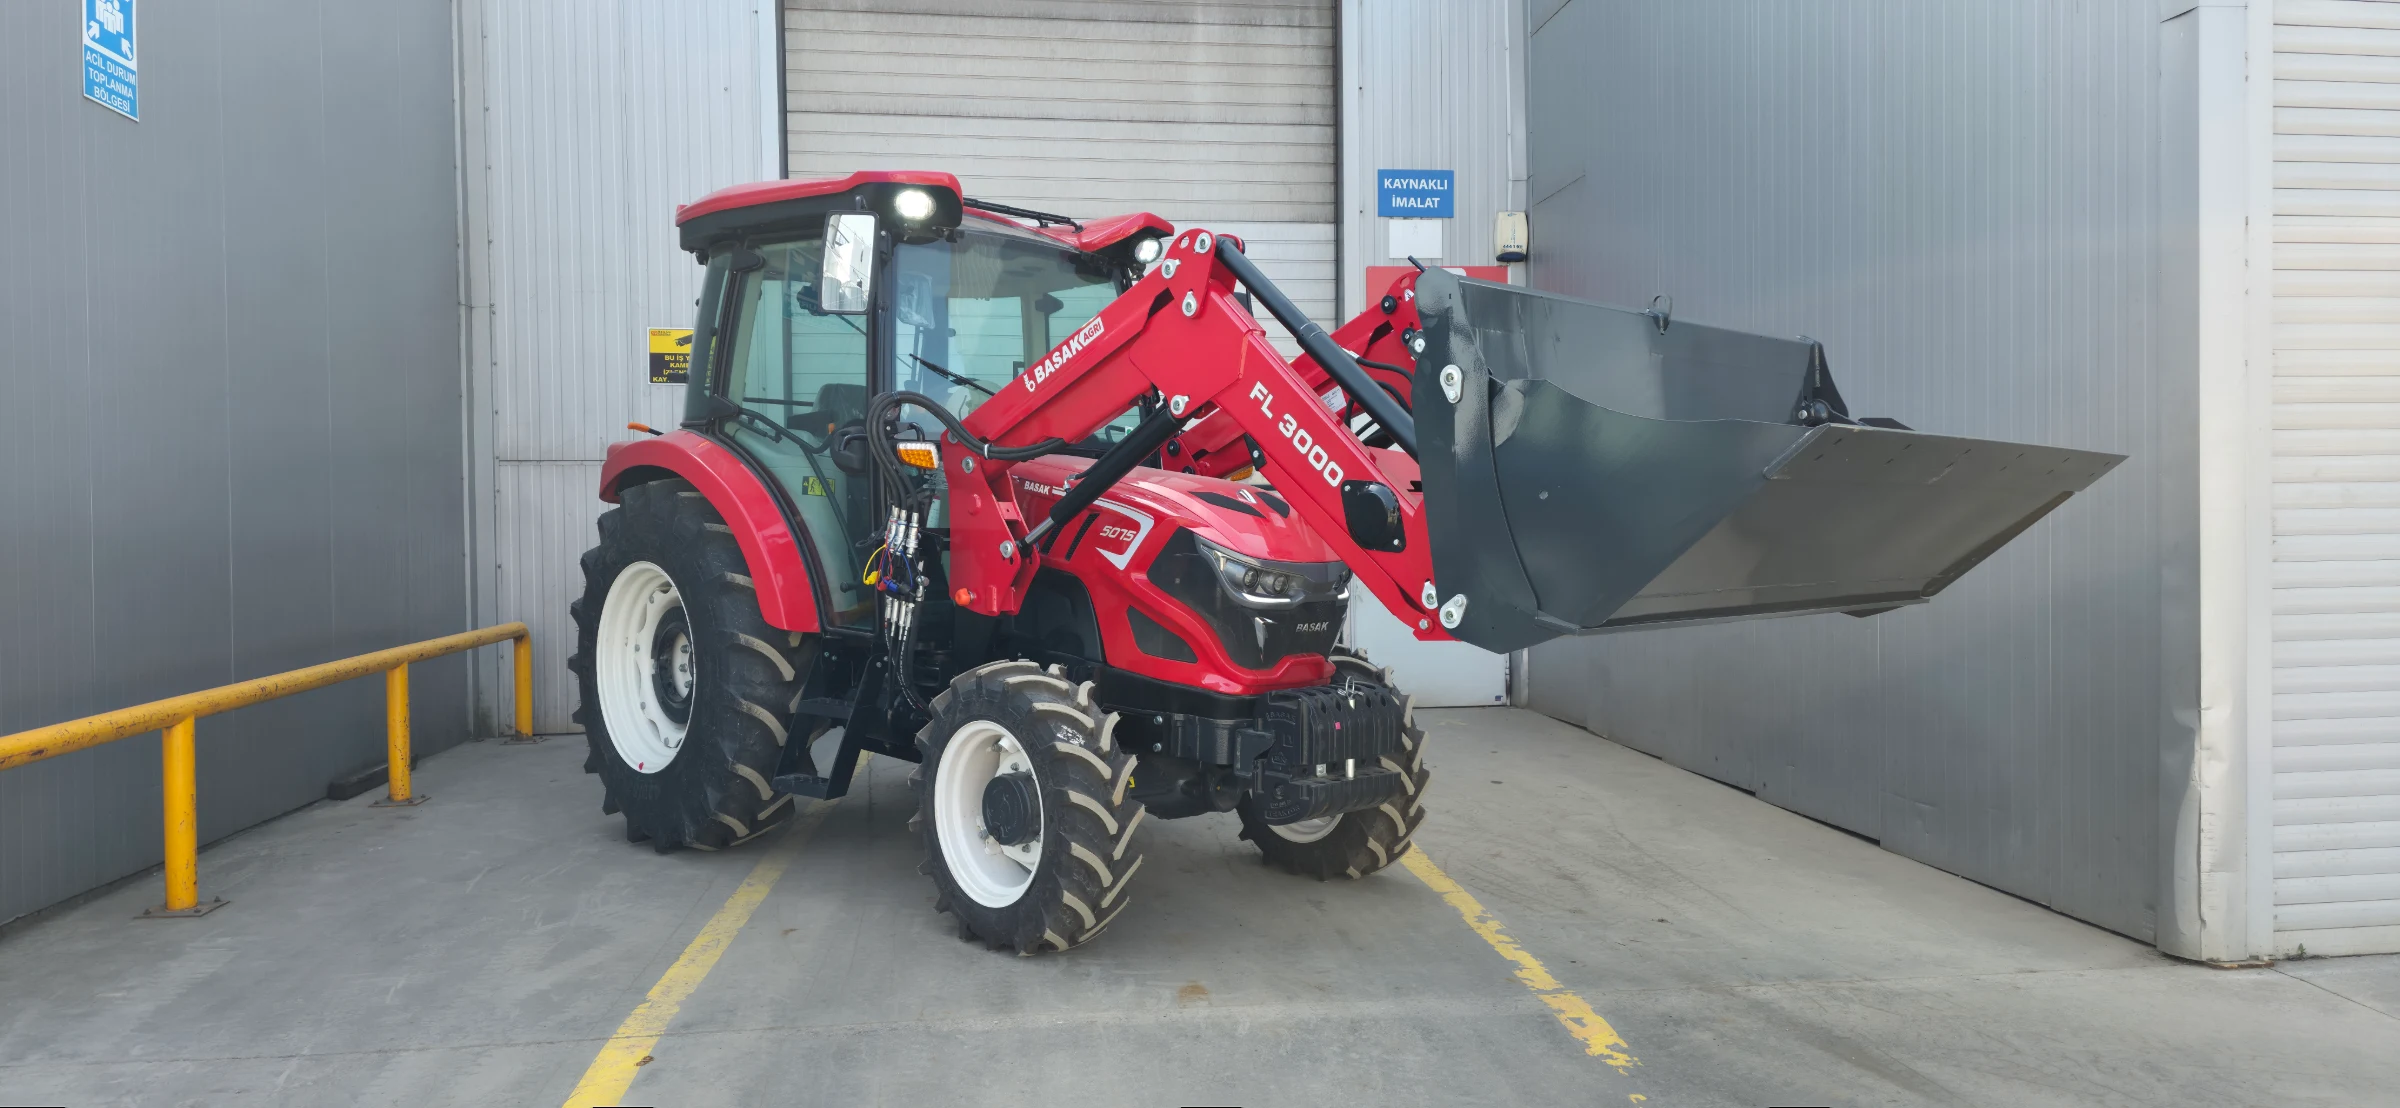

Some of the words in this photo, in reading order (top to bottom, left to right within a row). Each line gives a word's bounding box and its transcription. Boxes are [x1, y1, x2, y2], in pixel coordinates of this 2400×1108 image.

[86, 50, 105, 70] ACİL
[107, 60, 136, 86] DURUM
[88, 67, 134, 99] TOPLANMA
[94, 85, 130, 112] BÖLGESİ
[1384, 178, 1448, 190] KAYNAKLI
[1392, 194, 1440, 208] İMALAT
[676, 353, 684, 362] İŞ
[1034, 334, 1083, 384] BASAK
[1083, 322, 1102, 342] AGRI
[1249, 381, 1274, 420] FL
[1278, 413, 1344, 488] 3000
[1024, 481, 1050, 495] BASAK
[1100, 525, 1136, 542] 5075
[1296, 621, 1329, 632] BASAK
